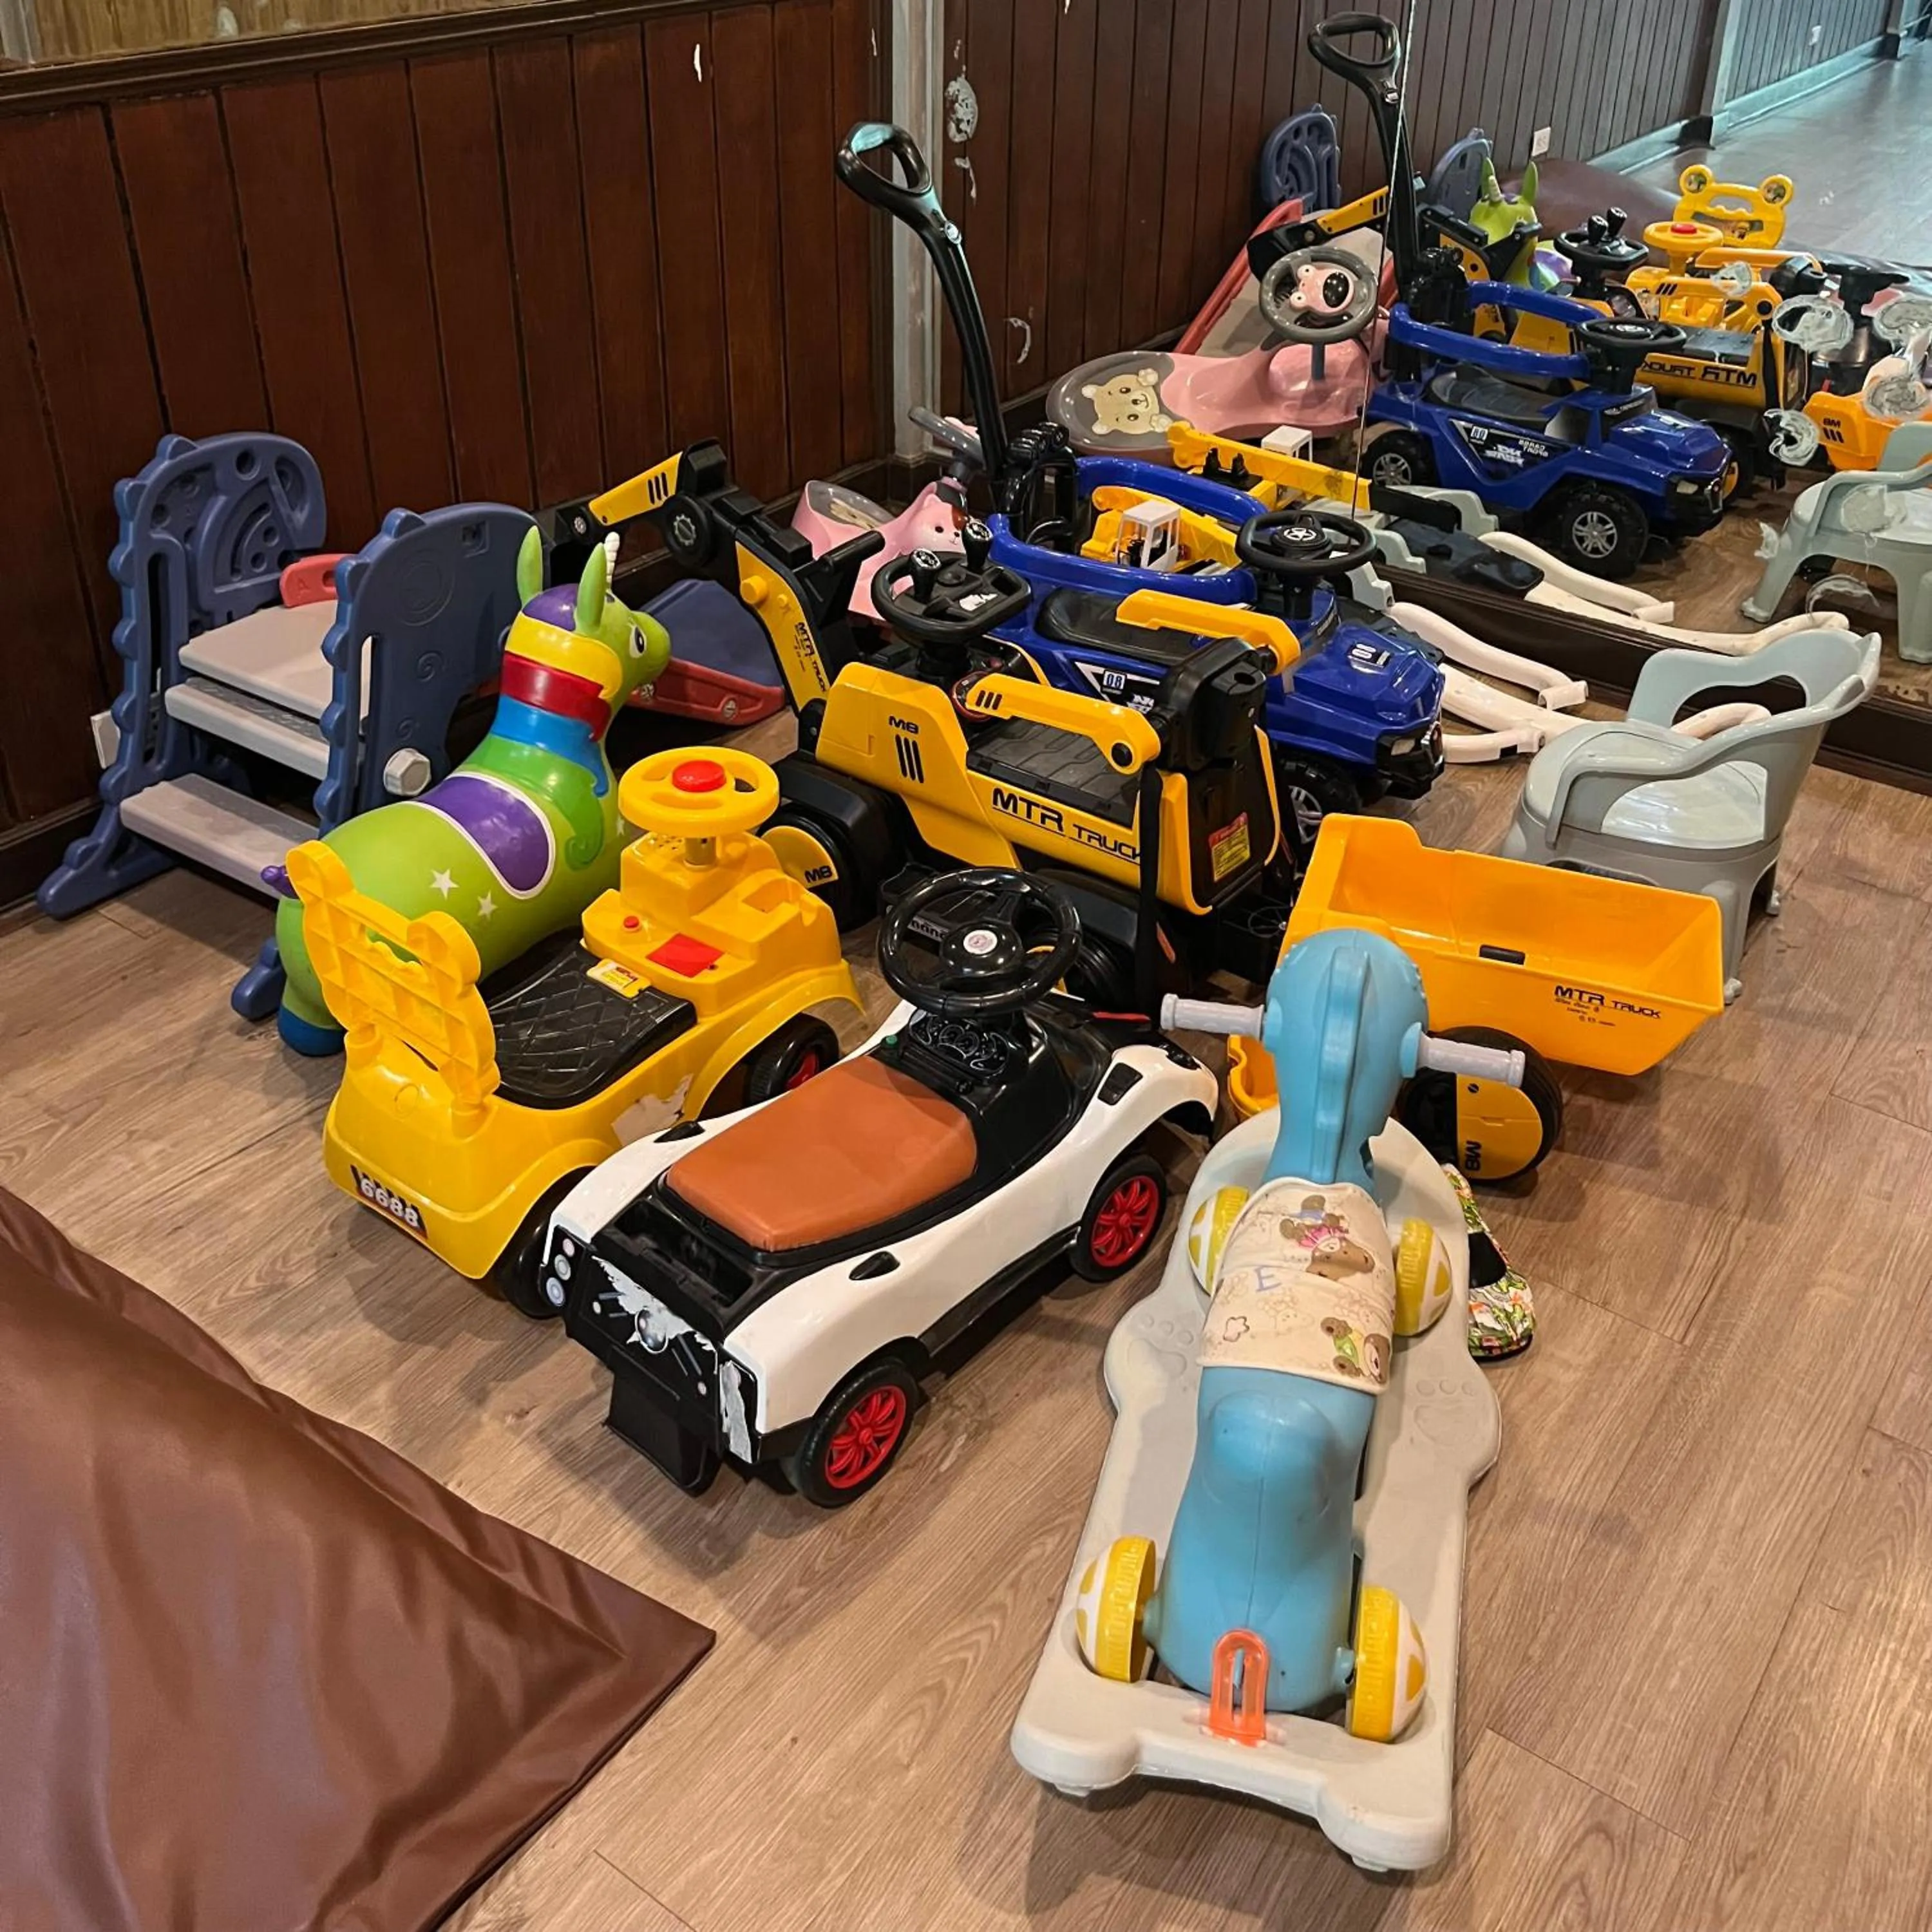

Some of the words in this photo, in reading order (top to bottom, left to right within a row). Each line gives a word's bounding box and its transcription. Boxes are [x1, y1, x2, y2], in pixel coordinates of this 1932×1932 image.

[795, 621, 815, 657] MTR
[1106, 673, 1122, 689] 08
[992, 787, 1065, 833] MTR
[1554, 985, 1605, 1006] MTR
[1611, 1000, 1662, 1019] TRUCK
[360, 1177, 419, 1227] 6688
